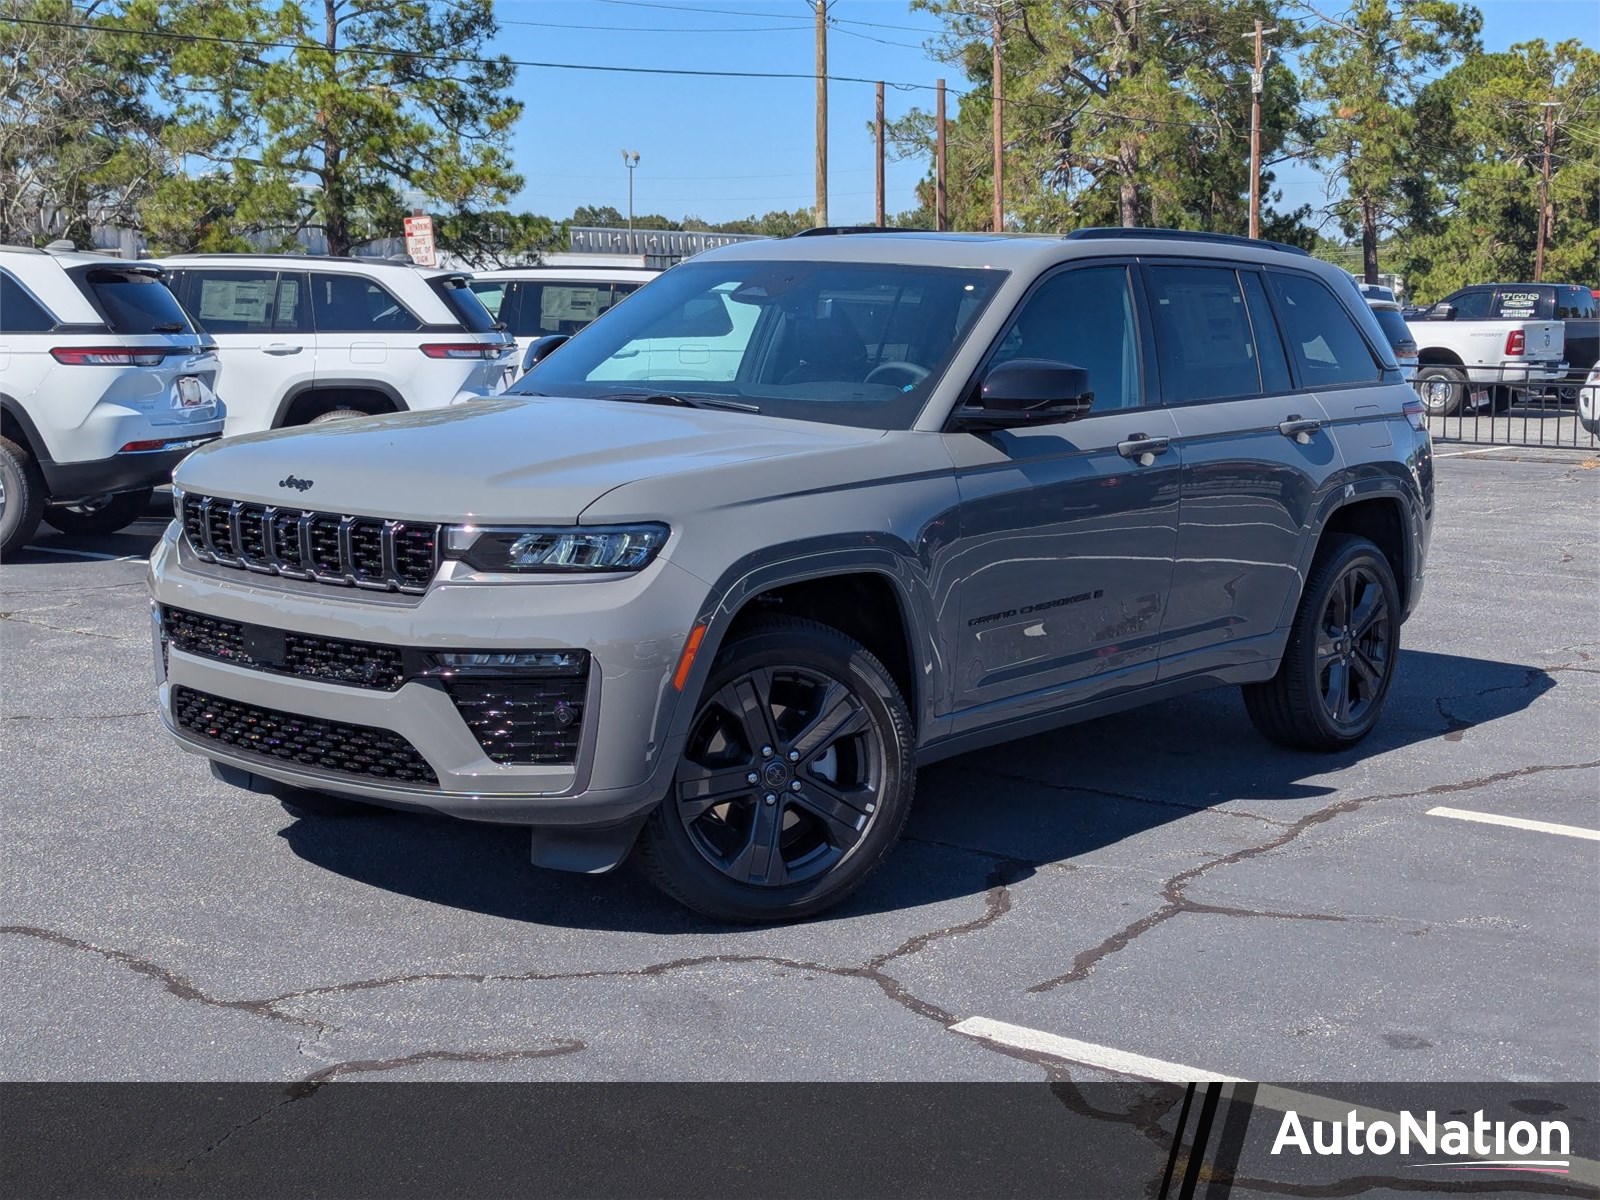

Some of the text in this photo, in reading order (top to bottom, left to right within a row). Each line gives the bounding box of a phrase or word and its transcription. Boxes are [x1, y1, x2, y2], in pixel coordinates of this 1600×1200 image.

[411, 247, 422, 255] SIDE
[279, 474, 314, 492] Jeep
[968, 592, 1092, 627] GRAND CHEROKEE
